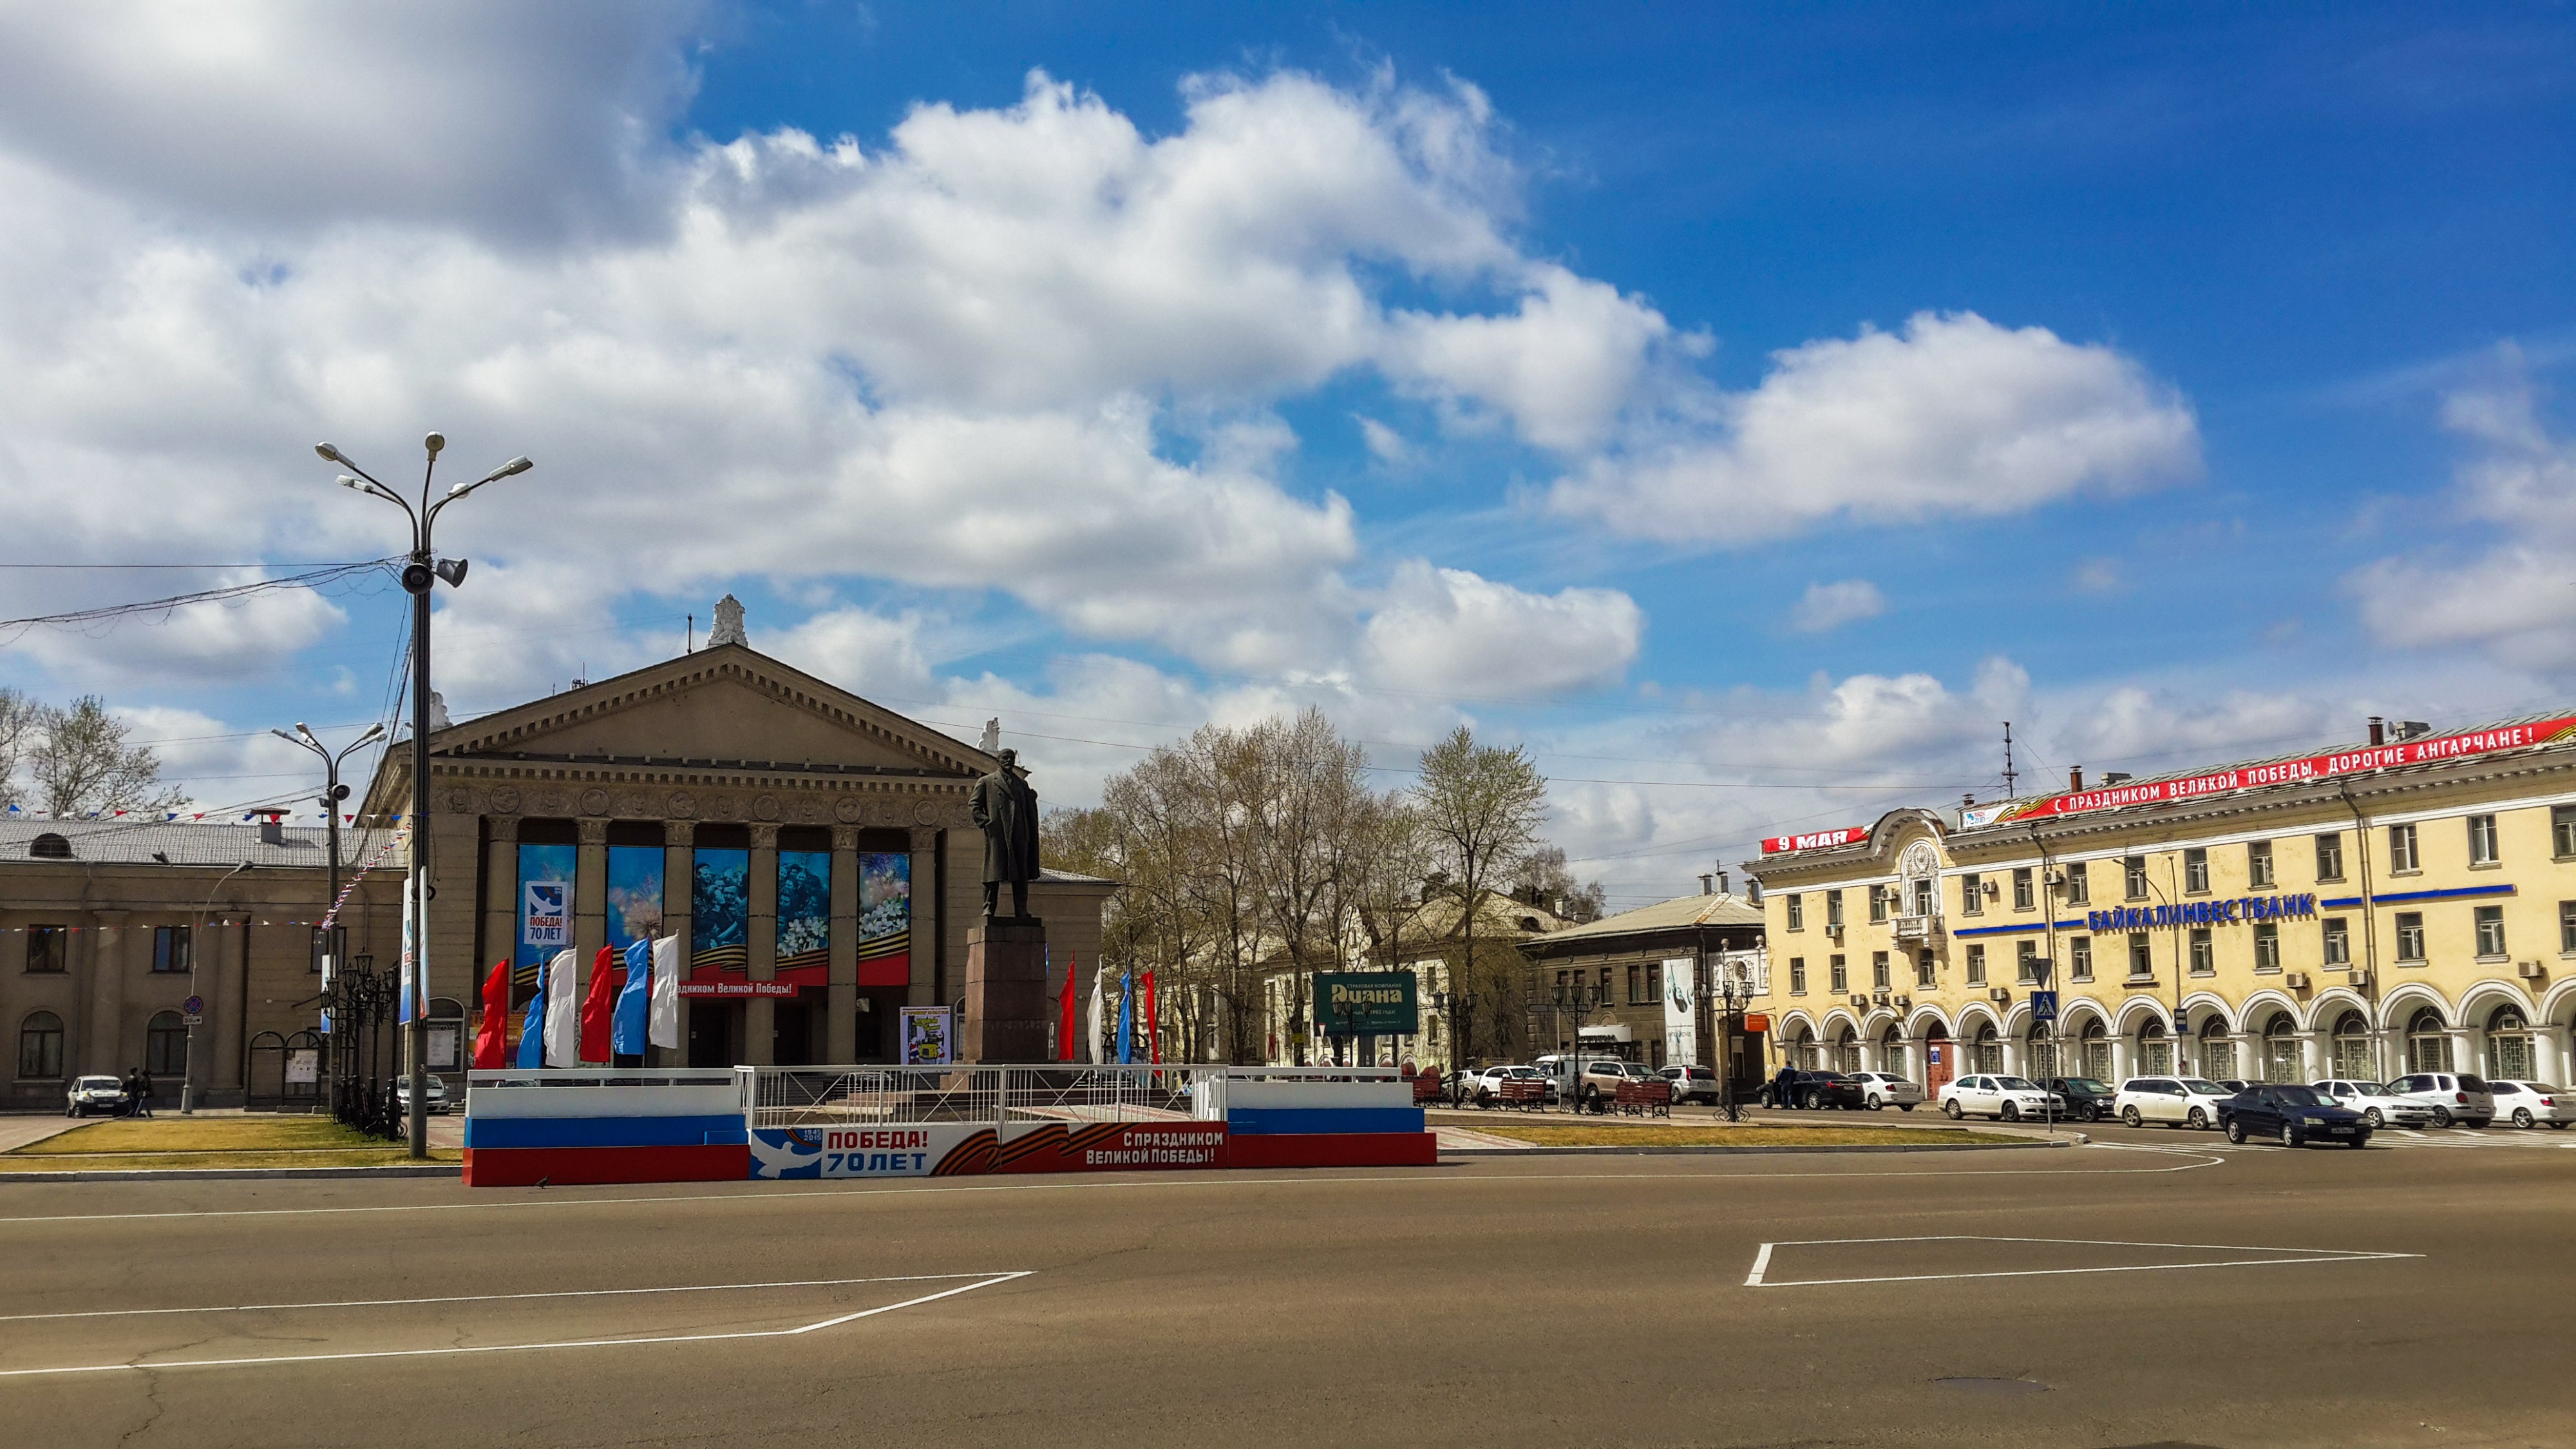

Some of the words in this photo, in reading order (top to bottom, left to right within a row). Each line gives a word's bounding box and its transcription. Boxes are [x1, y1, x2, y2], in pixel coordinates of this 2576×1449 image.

[2054, 799, 2061, 811] С
[2069, 784, 2160, 810] ПРАЗДНИКОМ
[2170, 771, 2238, 797] ВЕЛИКОЙ
[2248, 764, 2318, 785] ПОБЕДЫ,
[2328, 747, 2405, 773] ДОРОГИЕ
[1778, 837, 1790, 851] 9
[1796, 831, 1848, 849] МАЯ
[2088, 893, 2316, 931] БАЙКАЛИНВЕСТБАНК
[530, 916, 562, 927] ПОБЕДА!
[530, 927, 542, 940] 70
[544, 927, 562, 940] ЛЕТ
[677, 985, 715, 994] здником
[717, 983, 753, 994] Великой
[756, 983, 791, 994] Победы!
[1331, 984, 1403, 1003] Диана
[828, 1131, 927, 1149] ПОБЕДА!
[1124, 1132, 1132, 1146] С
[1135, 1132, 1223, 1147] ПРАЗДНИКОМ
[1086, 1148, 1149, 1164] ВЕЛИКОЙ
[1151, 1148, 1215, 1164] ПОБЕДЫ!
